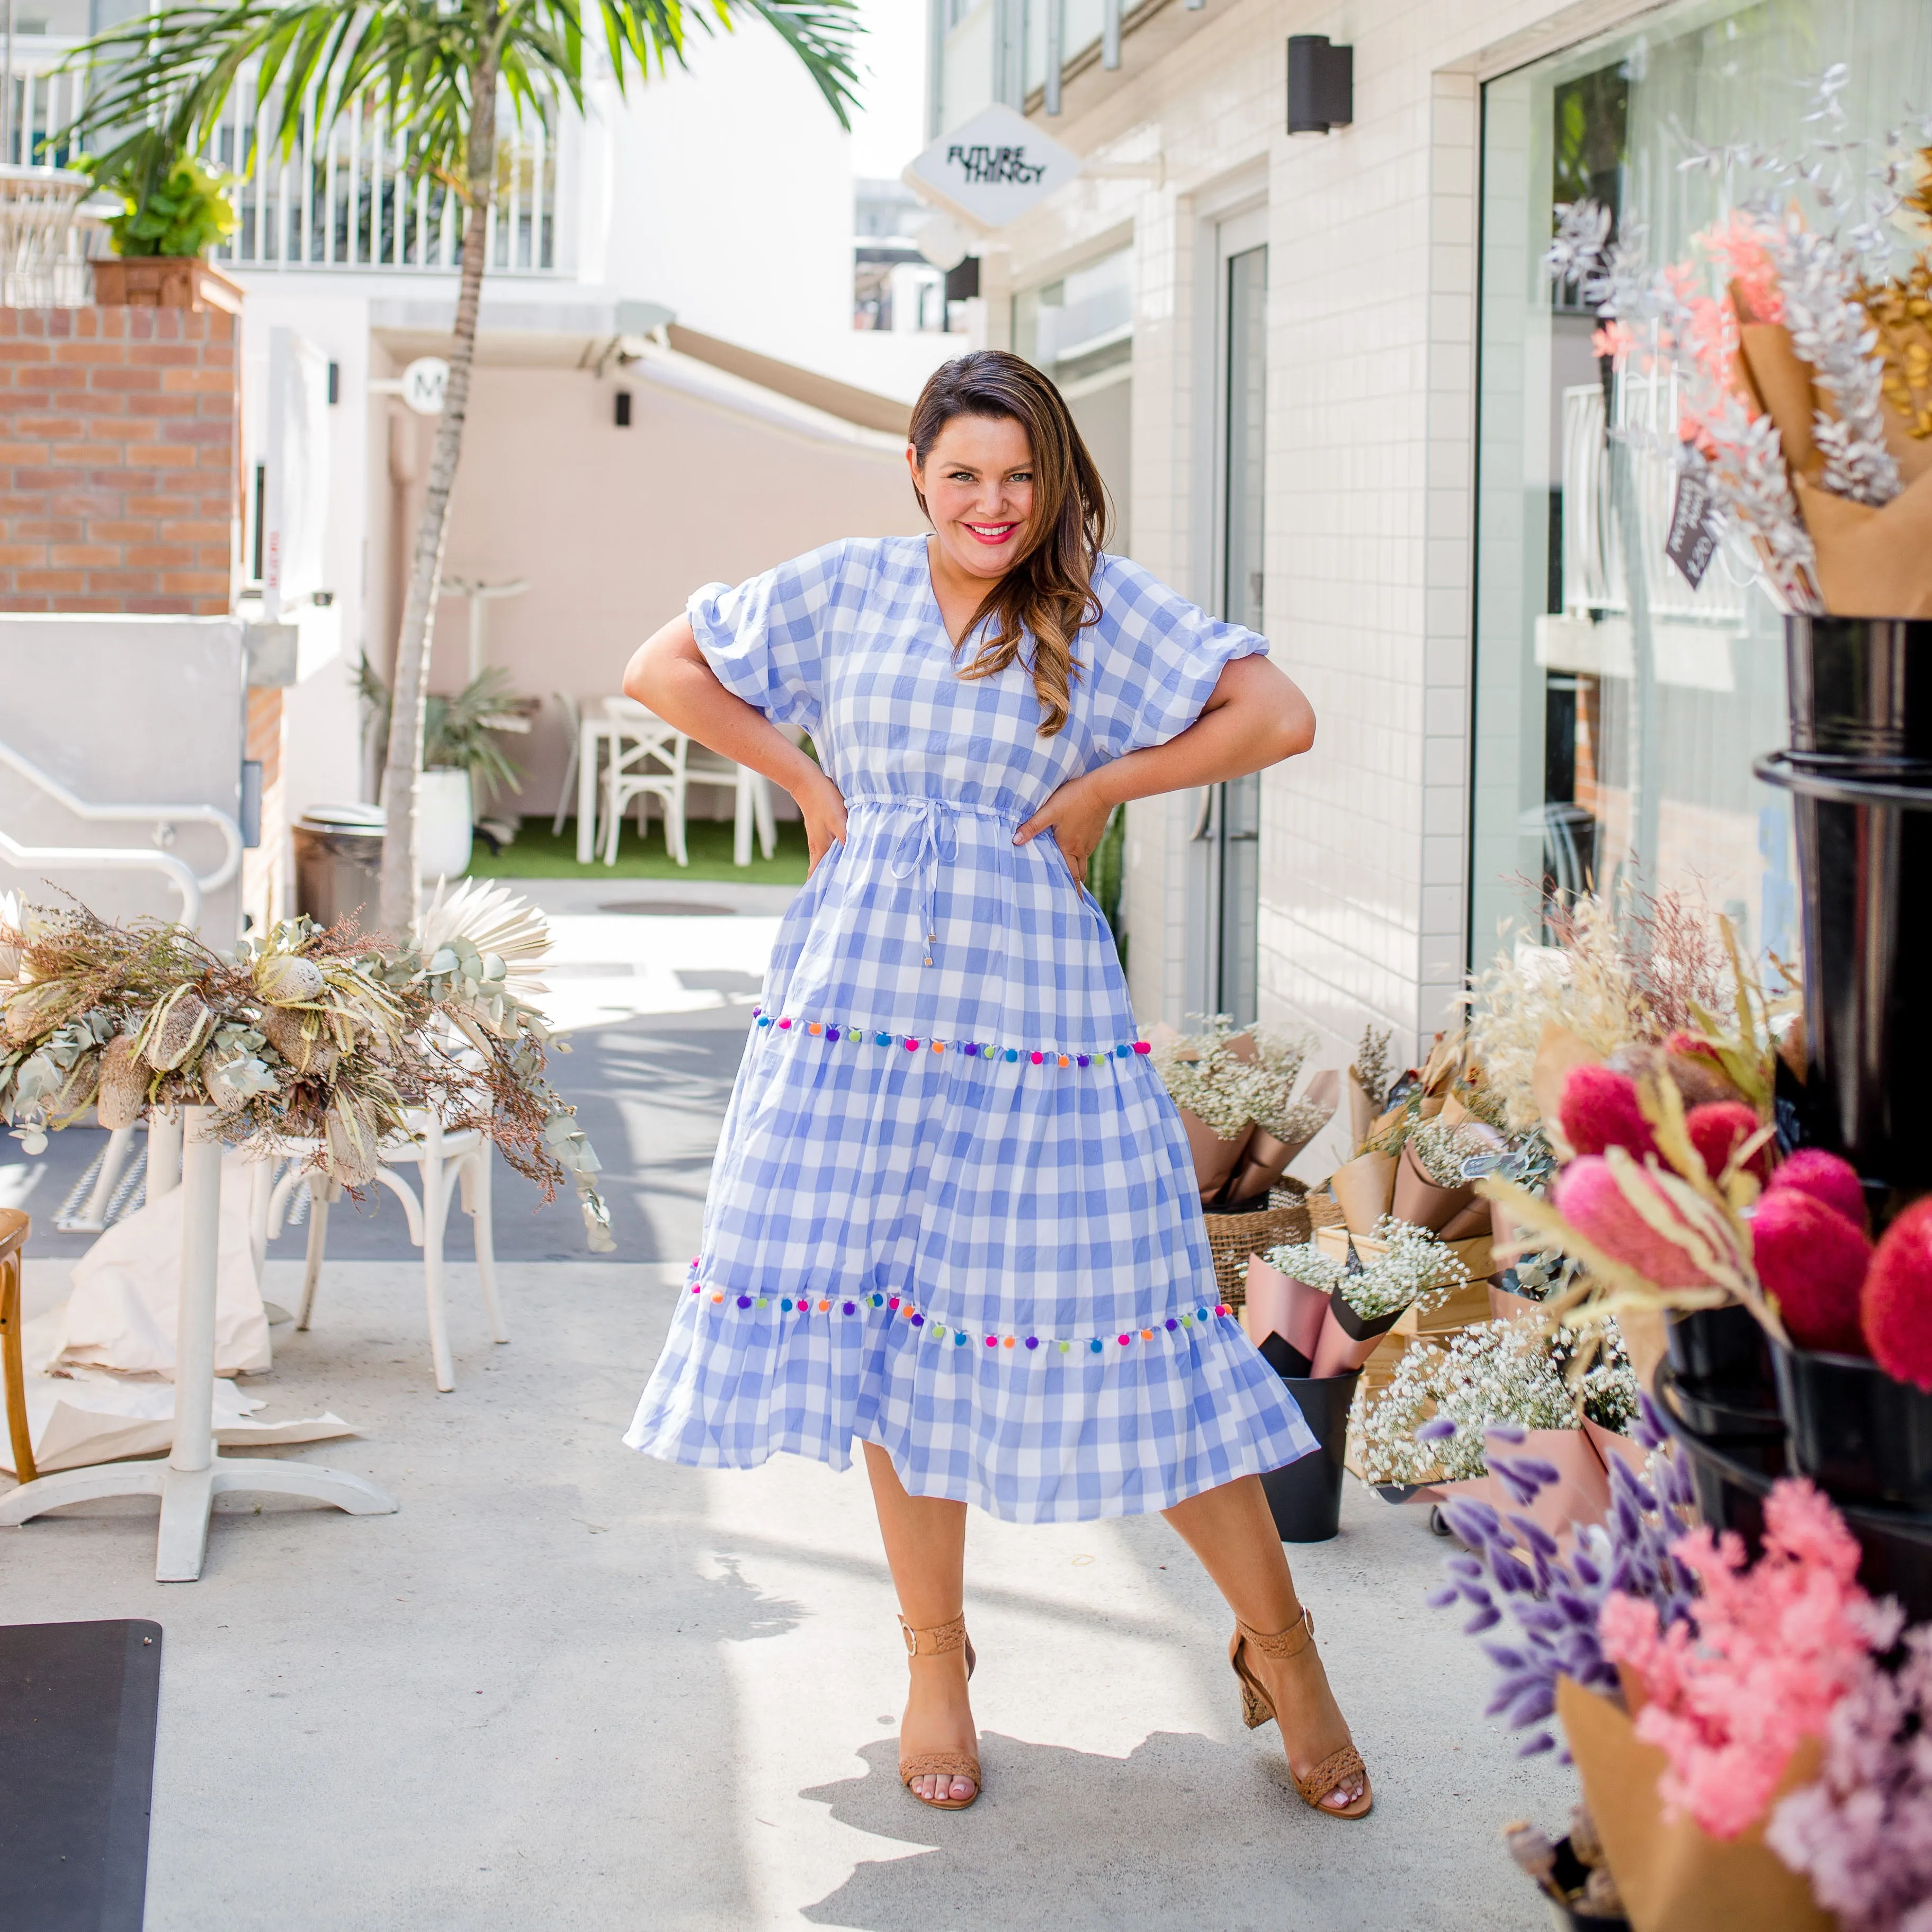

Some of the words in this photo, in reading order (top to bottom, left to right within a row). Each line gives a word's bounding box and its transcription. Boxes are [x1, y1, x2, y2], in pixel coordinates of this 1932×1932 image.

[946, 145, 1025, 166] FUTURE
[964, 162, 1046, 183] THINGY
[414, 372, 444, 399] M
